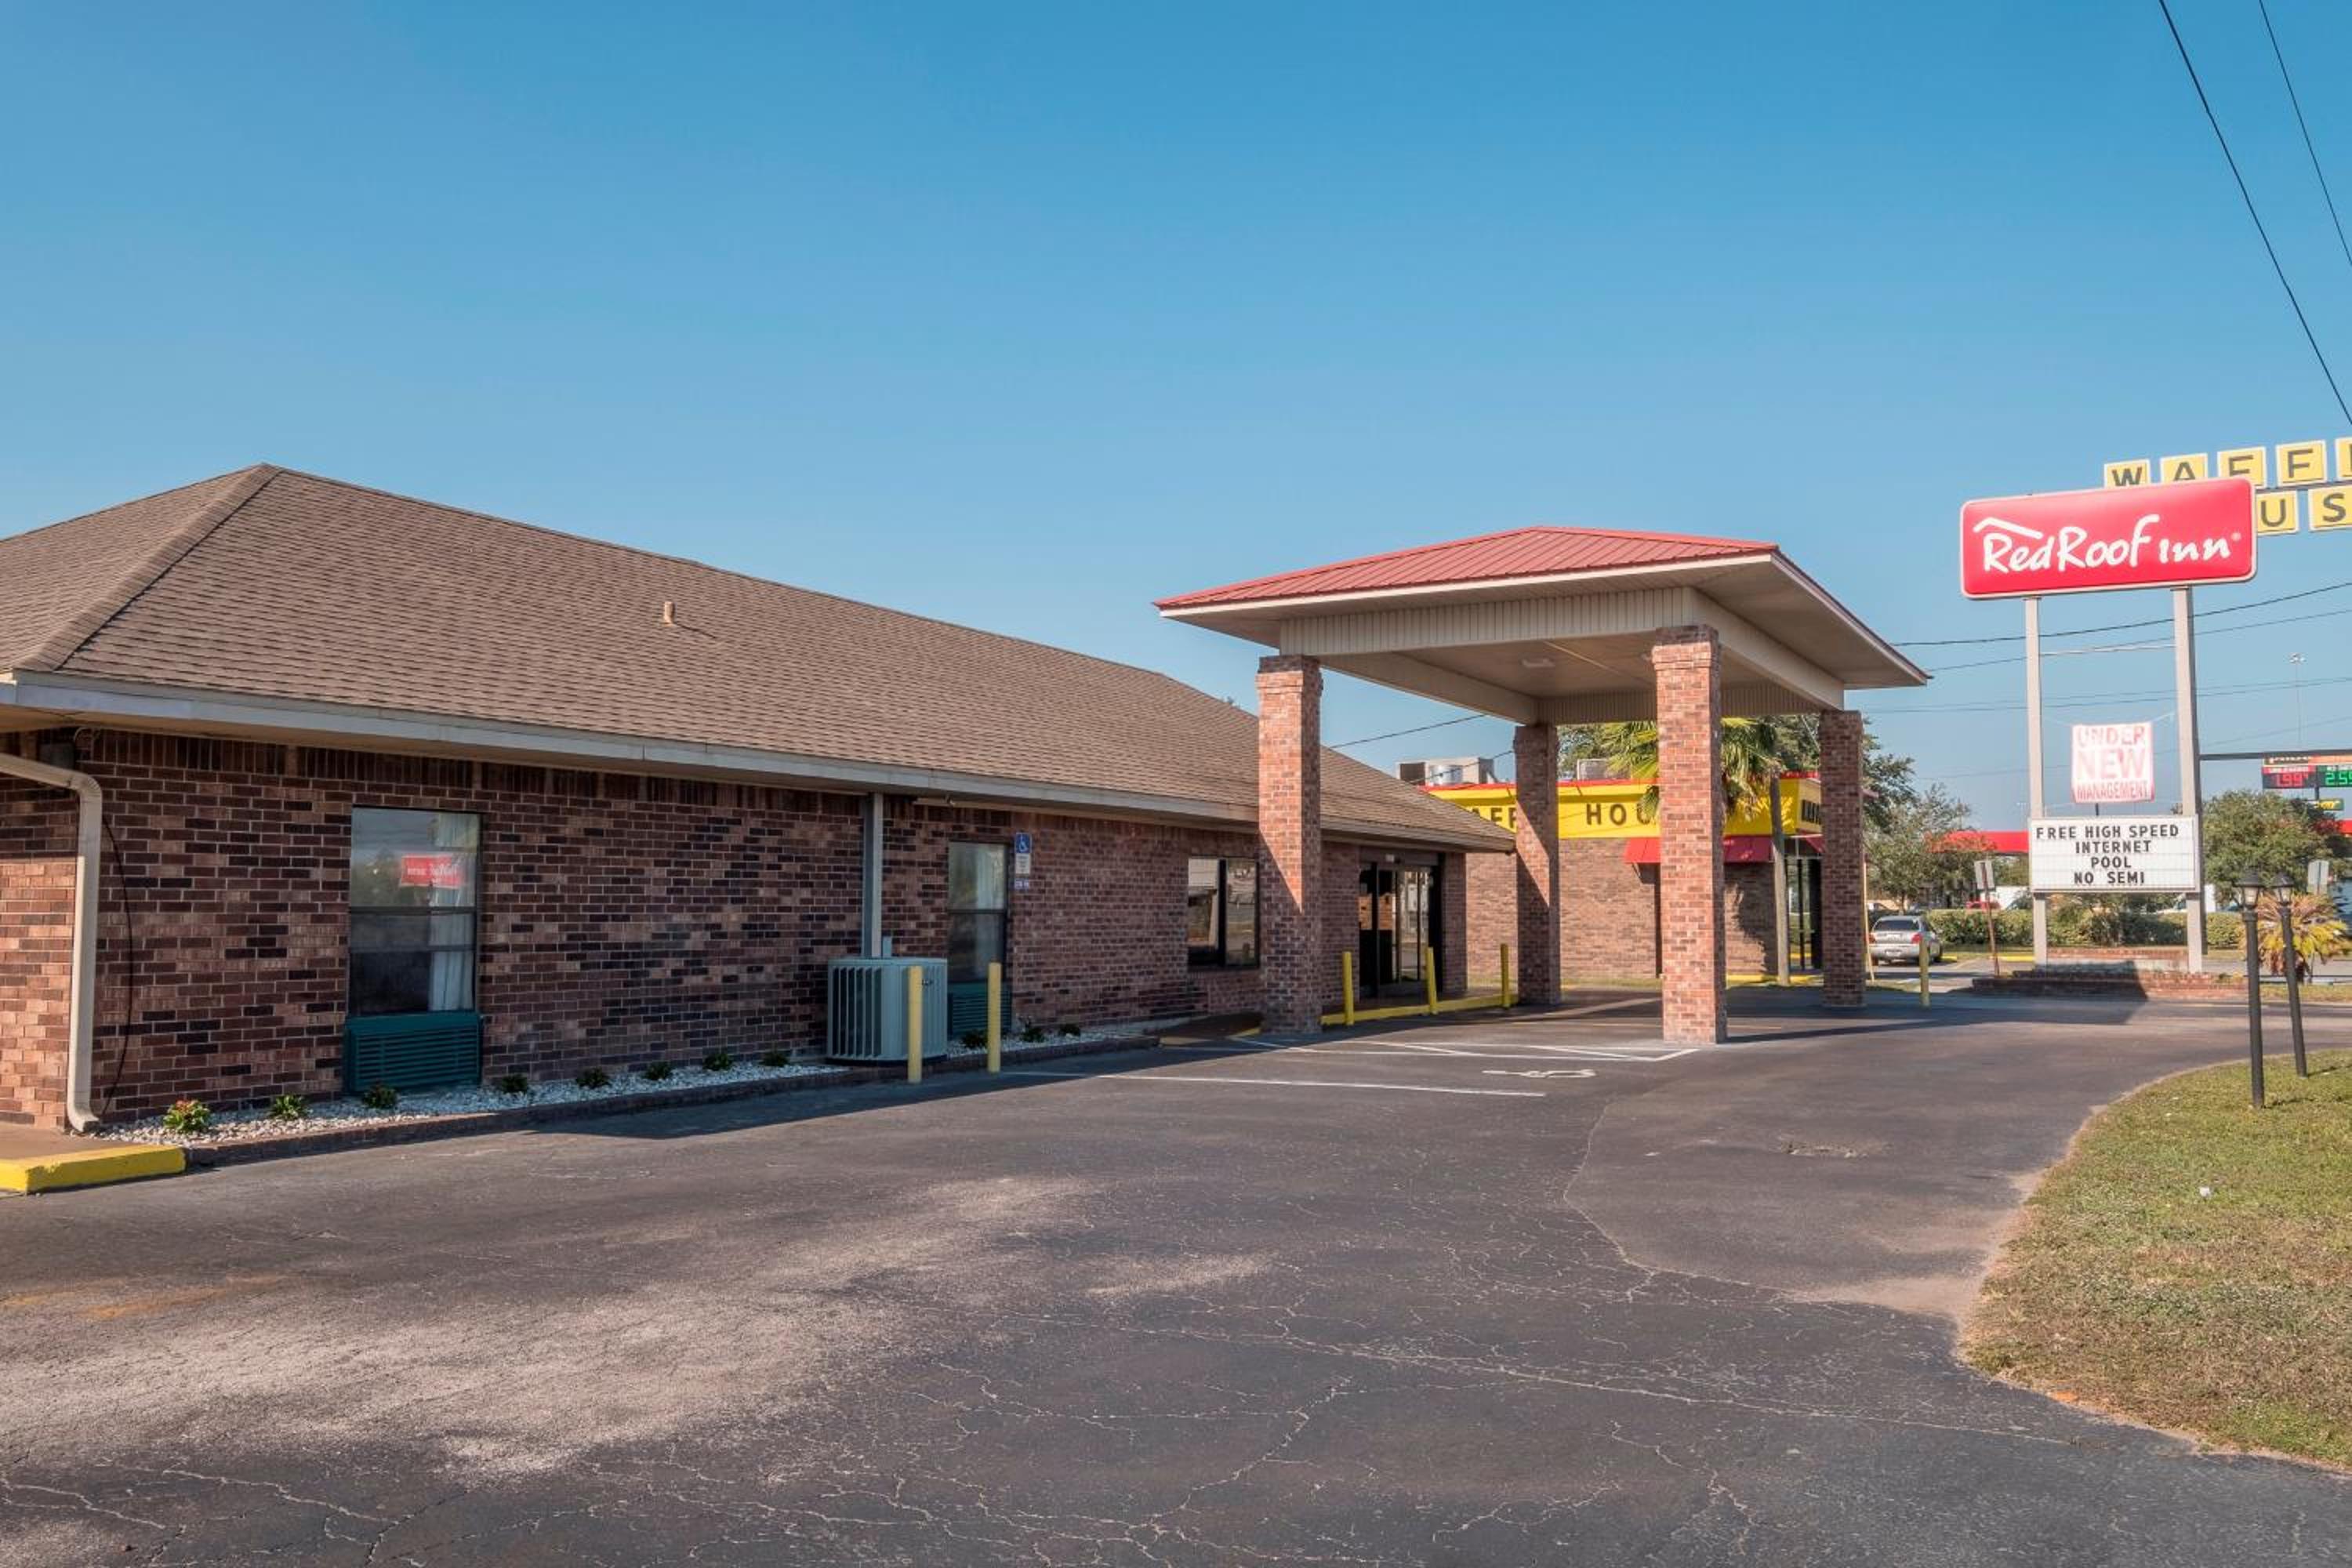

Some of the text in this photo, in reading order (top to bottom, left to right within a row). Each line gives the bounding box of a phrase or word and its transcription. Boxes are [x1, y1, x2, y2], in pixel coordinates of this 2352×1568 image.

[2111, 443, 2352, 487] WAFF
[2078, 727, 2145, 747] UNDER
[2076, 749, 2146, 779] NEW
[2077, 781, 2149, 800] MANAGEMENT
[2036, 824, 2180, 840] FREE HIGH SPEED
[2075, 840, 2152, 854] INTERNET
[2091, 855, 2132, 869] POOL
[2074, 871, 2145, 884] NO SEMI
